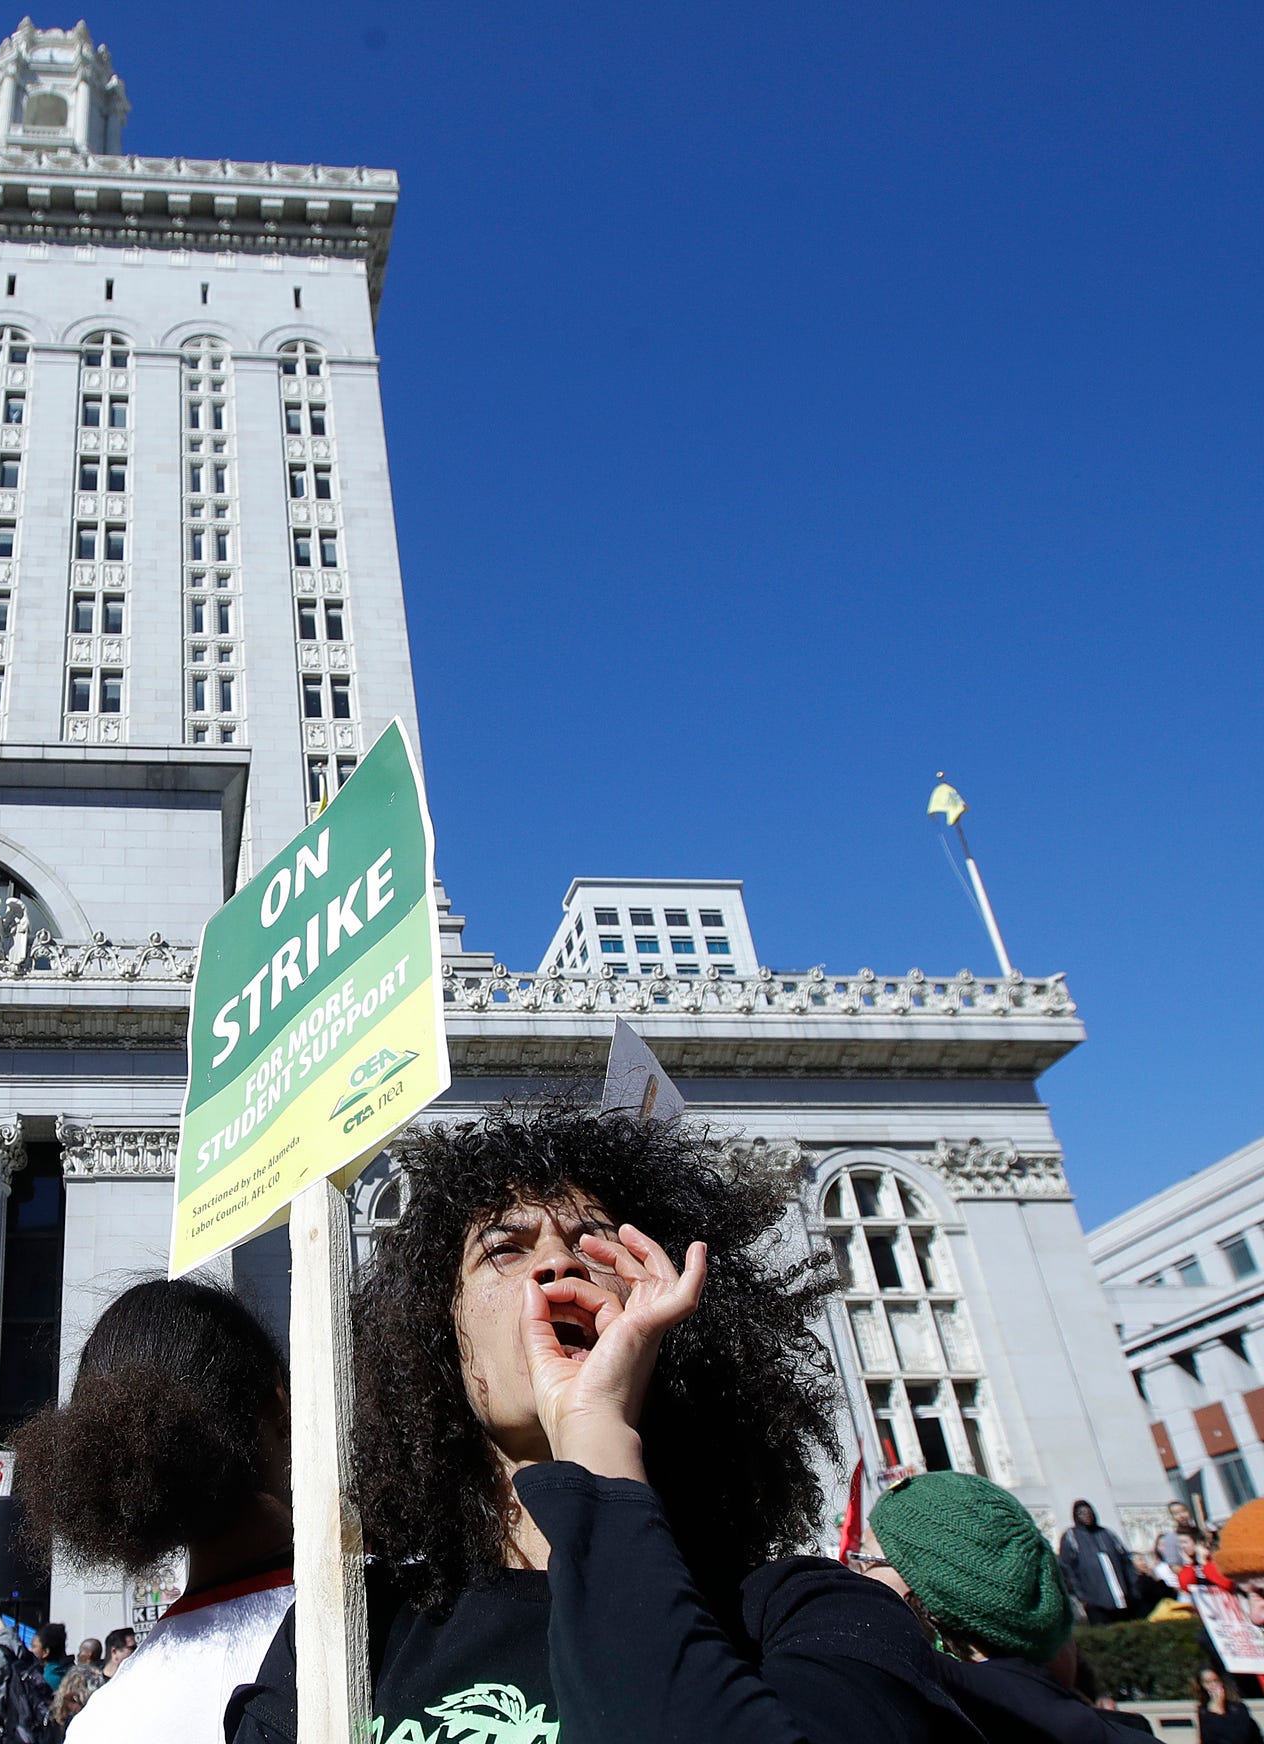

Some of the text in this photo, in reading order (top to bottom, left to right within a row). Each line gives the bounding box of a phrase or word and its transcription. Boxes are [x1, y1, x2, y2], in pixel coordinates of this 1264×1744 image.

[260, 826, 330, 929] ON
[211, 847, 396, 1069] STRIKE
[196, 954, 410, 1174] STUDENT SUPPORT
[245, 978, 355, 1106] FOR MORE
[349, 1047, 398, 1088] OEA
[343, 1081, 404, 1134] CTA nea
[191, 1171, 281, 1238] Labor Council, AFL-CIO
[192, 1136, 300, 1218] Sanctioned by the Alameda
